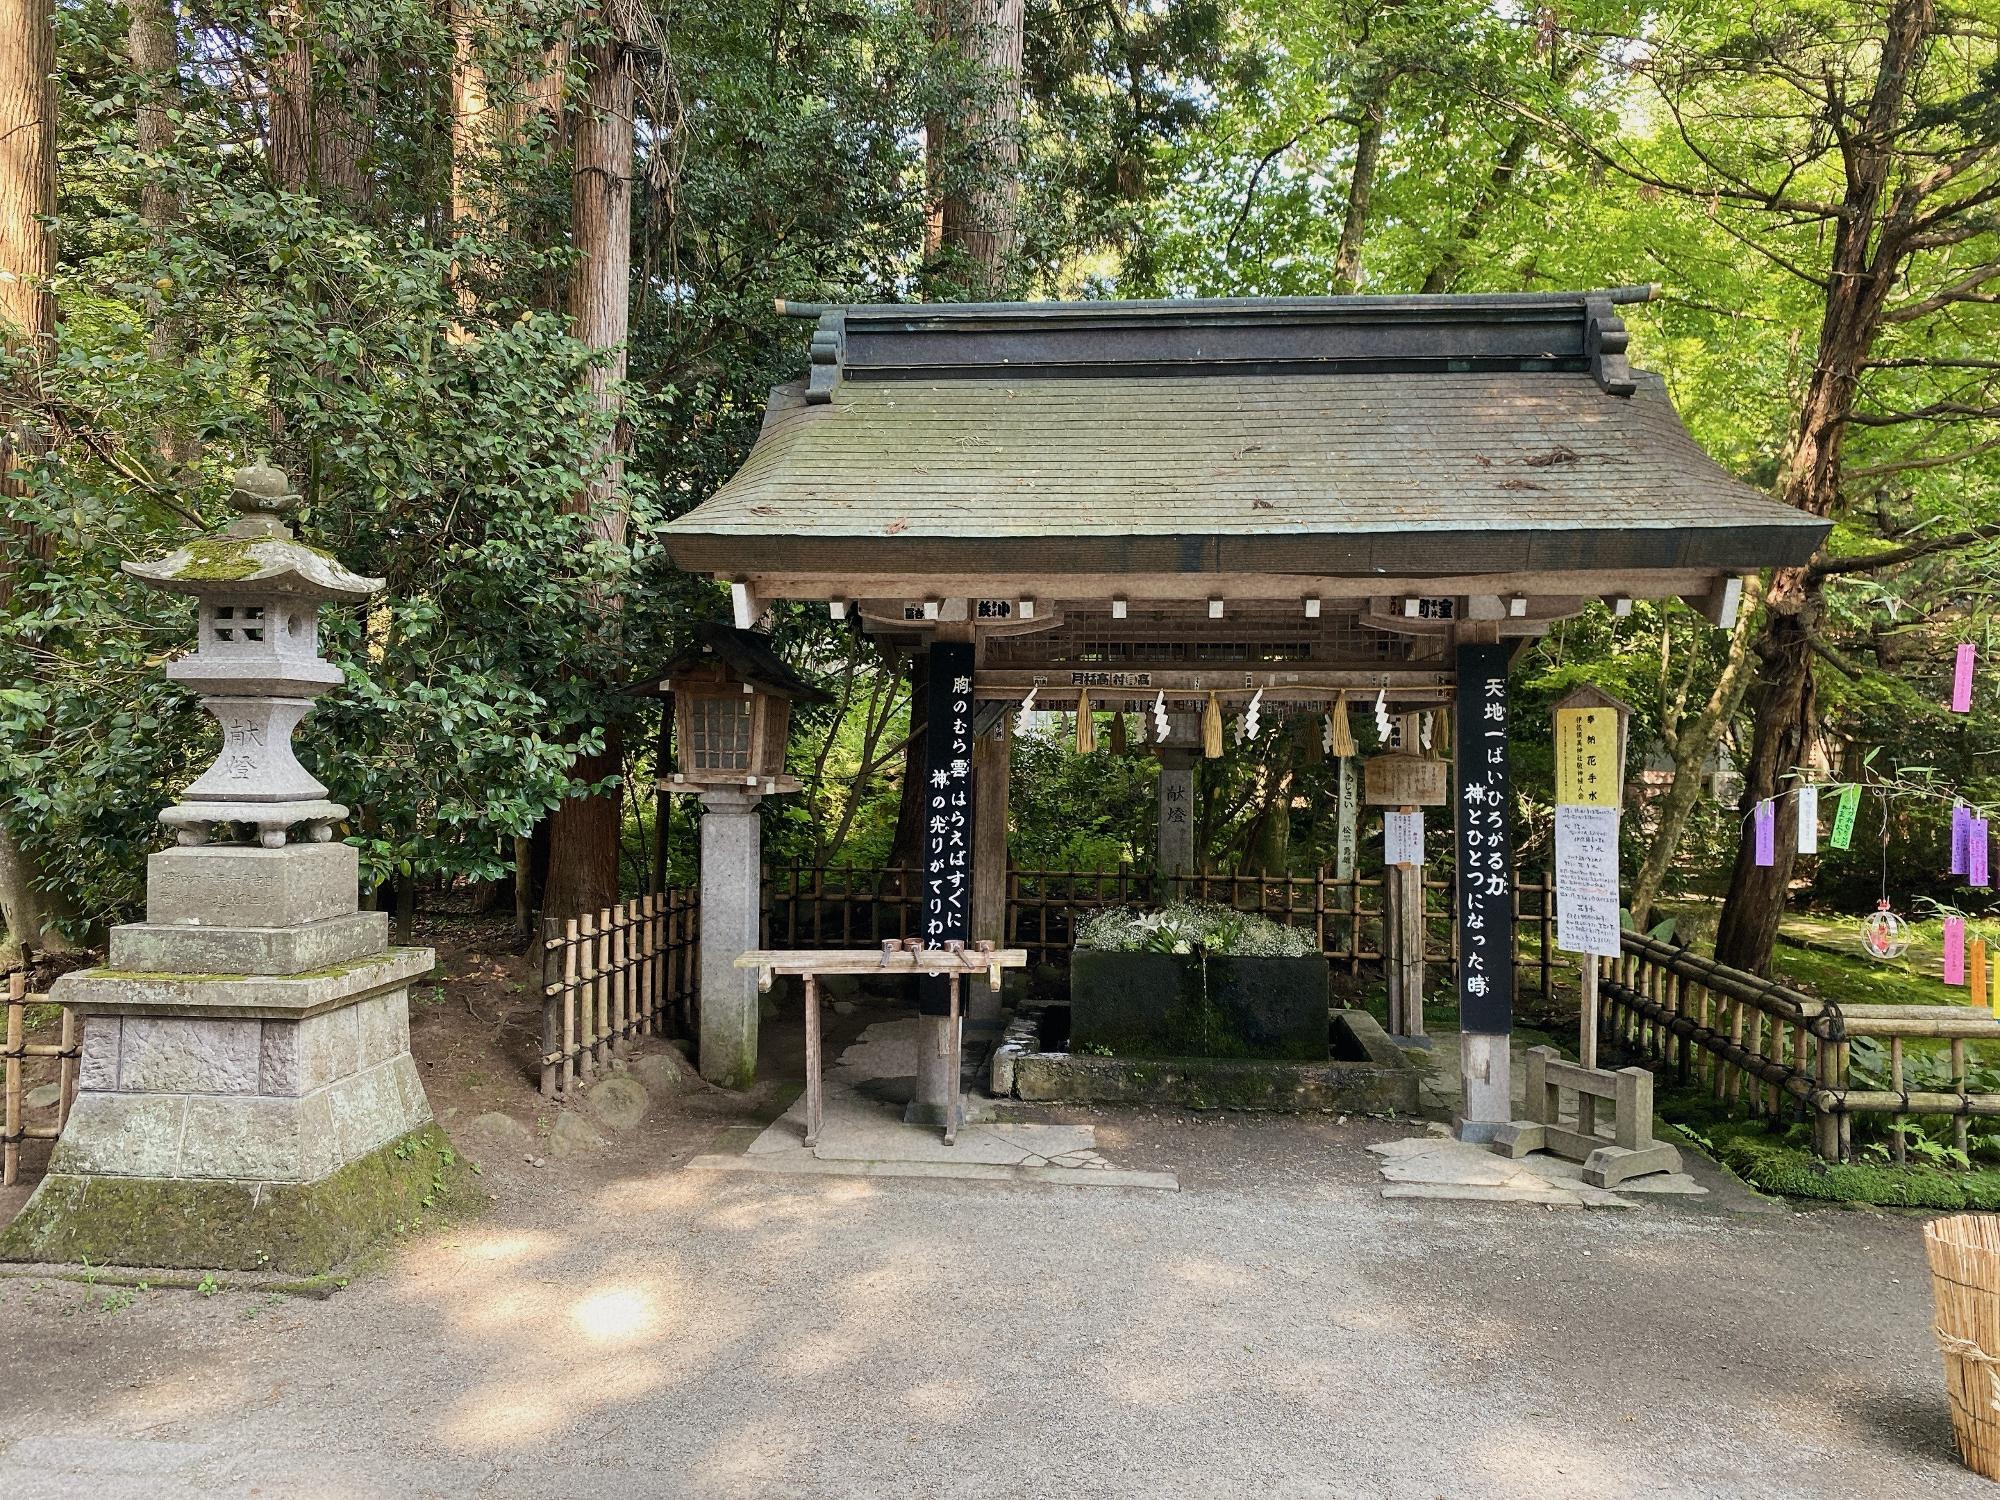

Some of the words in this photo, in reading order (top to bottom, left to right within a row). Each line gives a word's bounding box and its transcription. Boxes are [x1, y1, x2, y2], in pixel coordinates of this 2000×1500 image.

[225, 718, 264, 780] 献燈
[946, 675, 970, 928] 胸のむら雲、はらえばすぐに
[1167, 785, 1187, 824] 献燈
[1483, 678, 1505, 896] 天地一ぱいひろがる力
[1586, 714, 1598, 801] 奉納花手水
[1464, 782, 1486, 998] 神とひとつになった時
